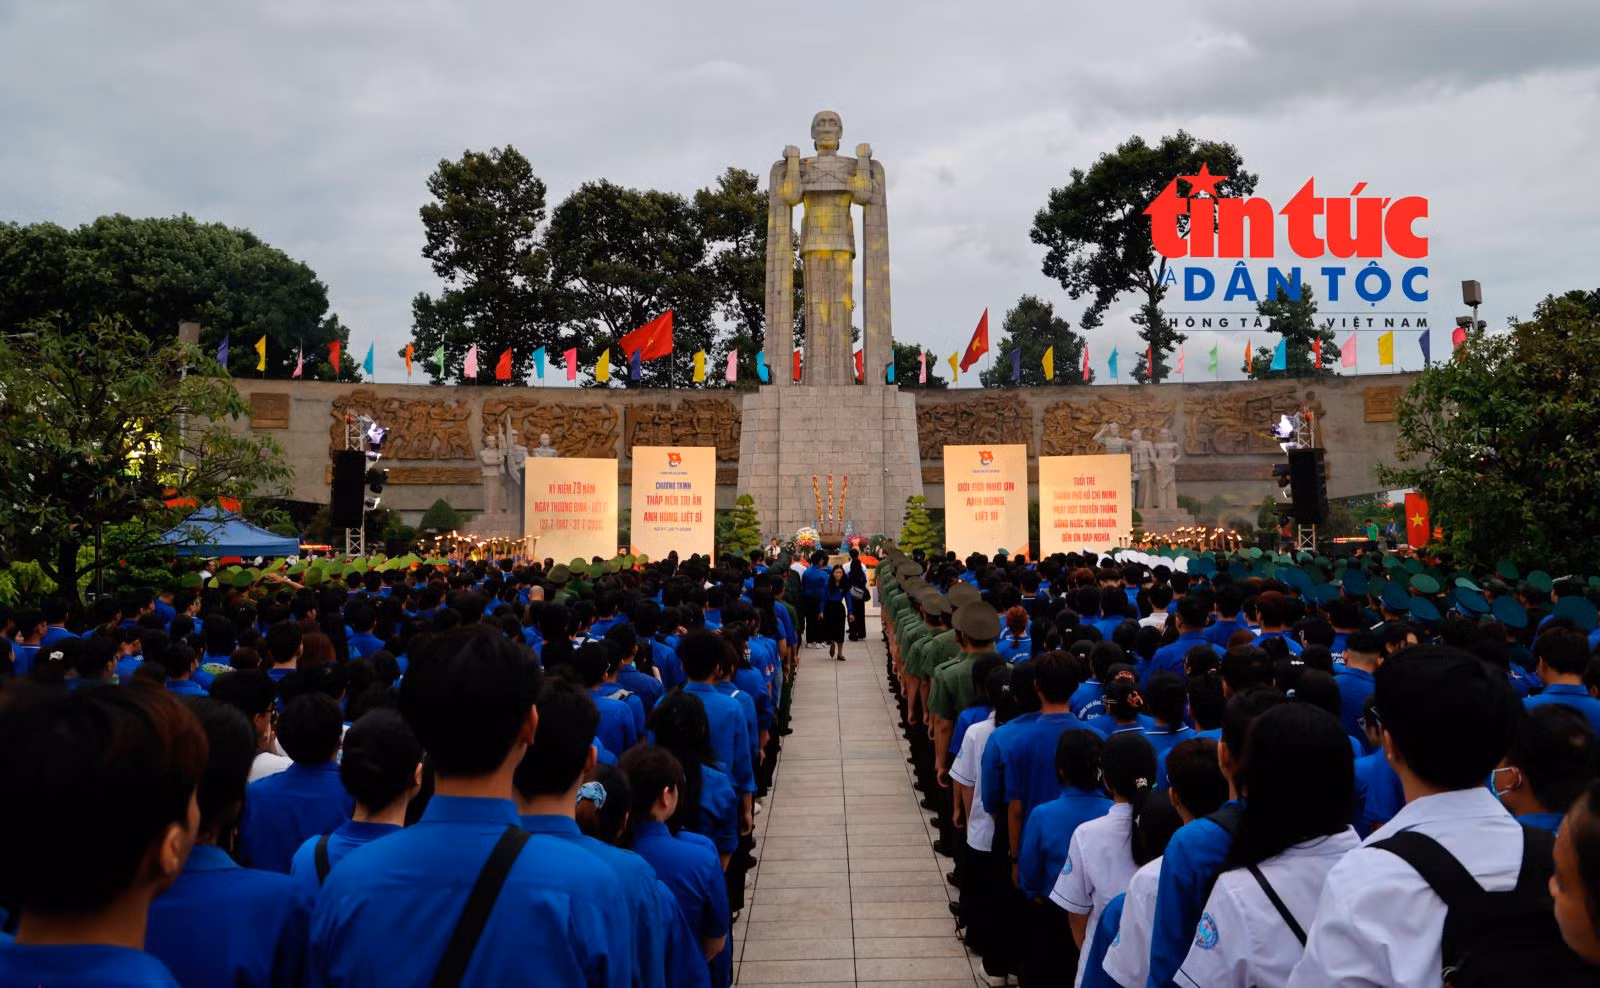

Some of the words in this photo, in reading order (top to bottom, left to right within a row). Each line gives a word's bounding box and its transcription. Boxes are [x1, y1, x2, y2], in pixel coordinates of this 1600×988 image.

[572, 481, 582, 494] 79
[1101, 490, 1117, 500] MINH
[643, 511, 658, 523] ANH
